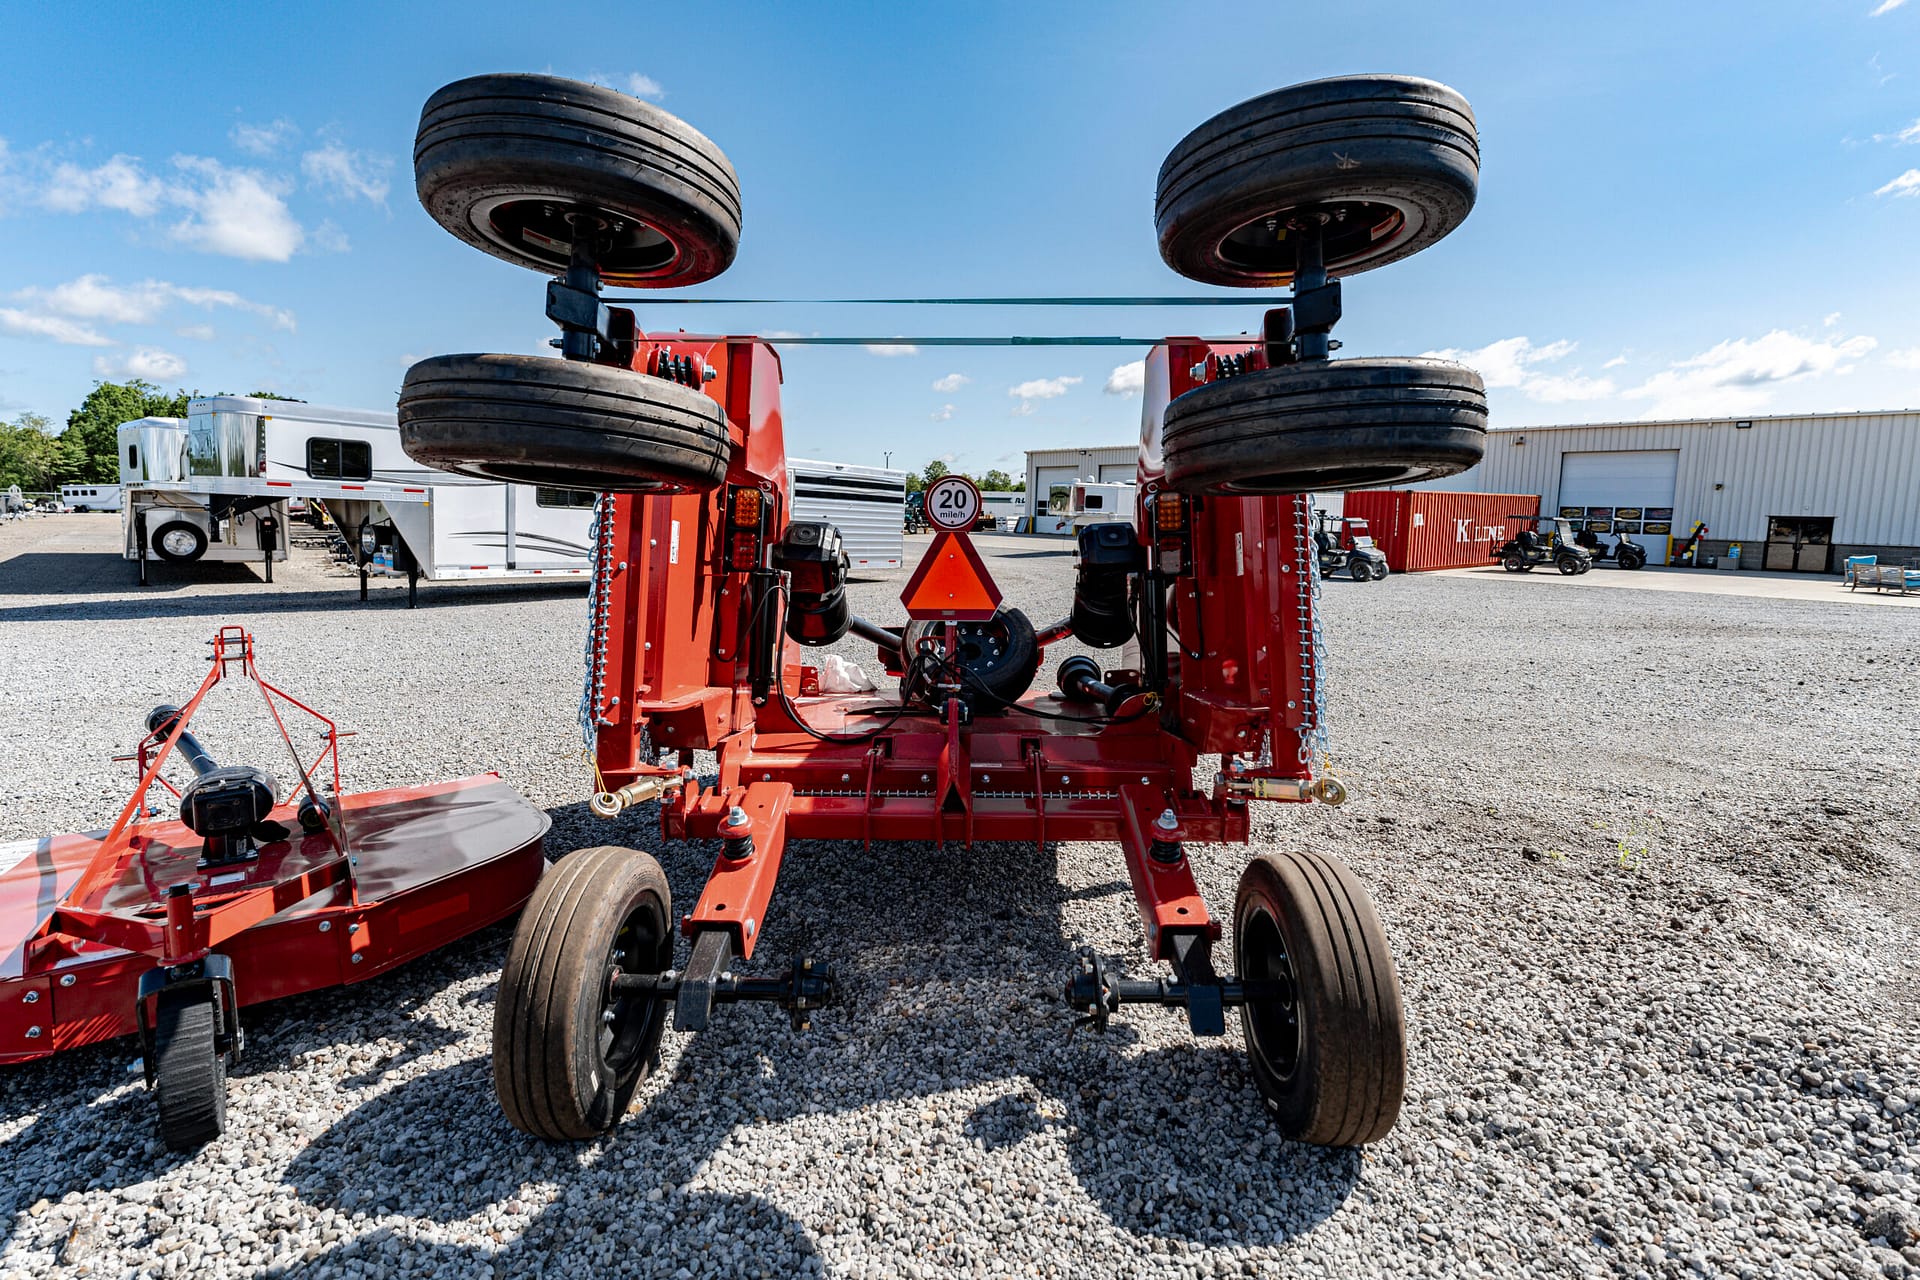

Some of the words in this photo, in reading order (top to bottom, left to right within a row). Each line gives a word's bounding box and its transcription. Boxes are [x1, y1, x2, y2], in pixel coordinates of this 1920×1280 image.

[939, 489, 967, 509] 20
[940, 510, 966, 518] mile/h
[1474, 526, 1505, 542] LINE
